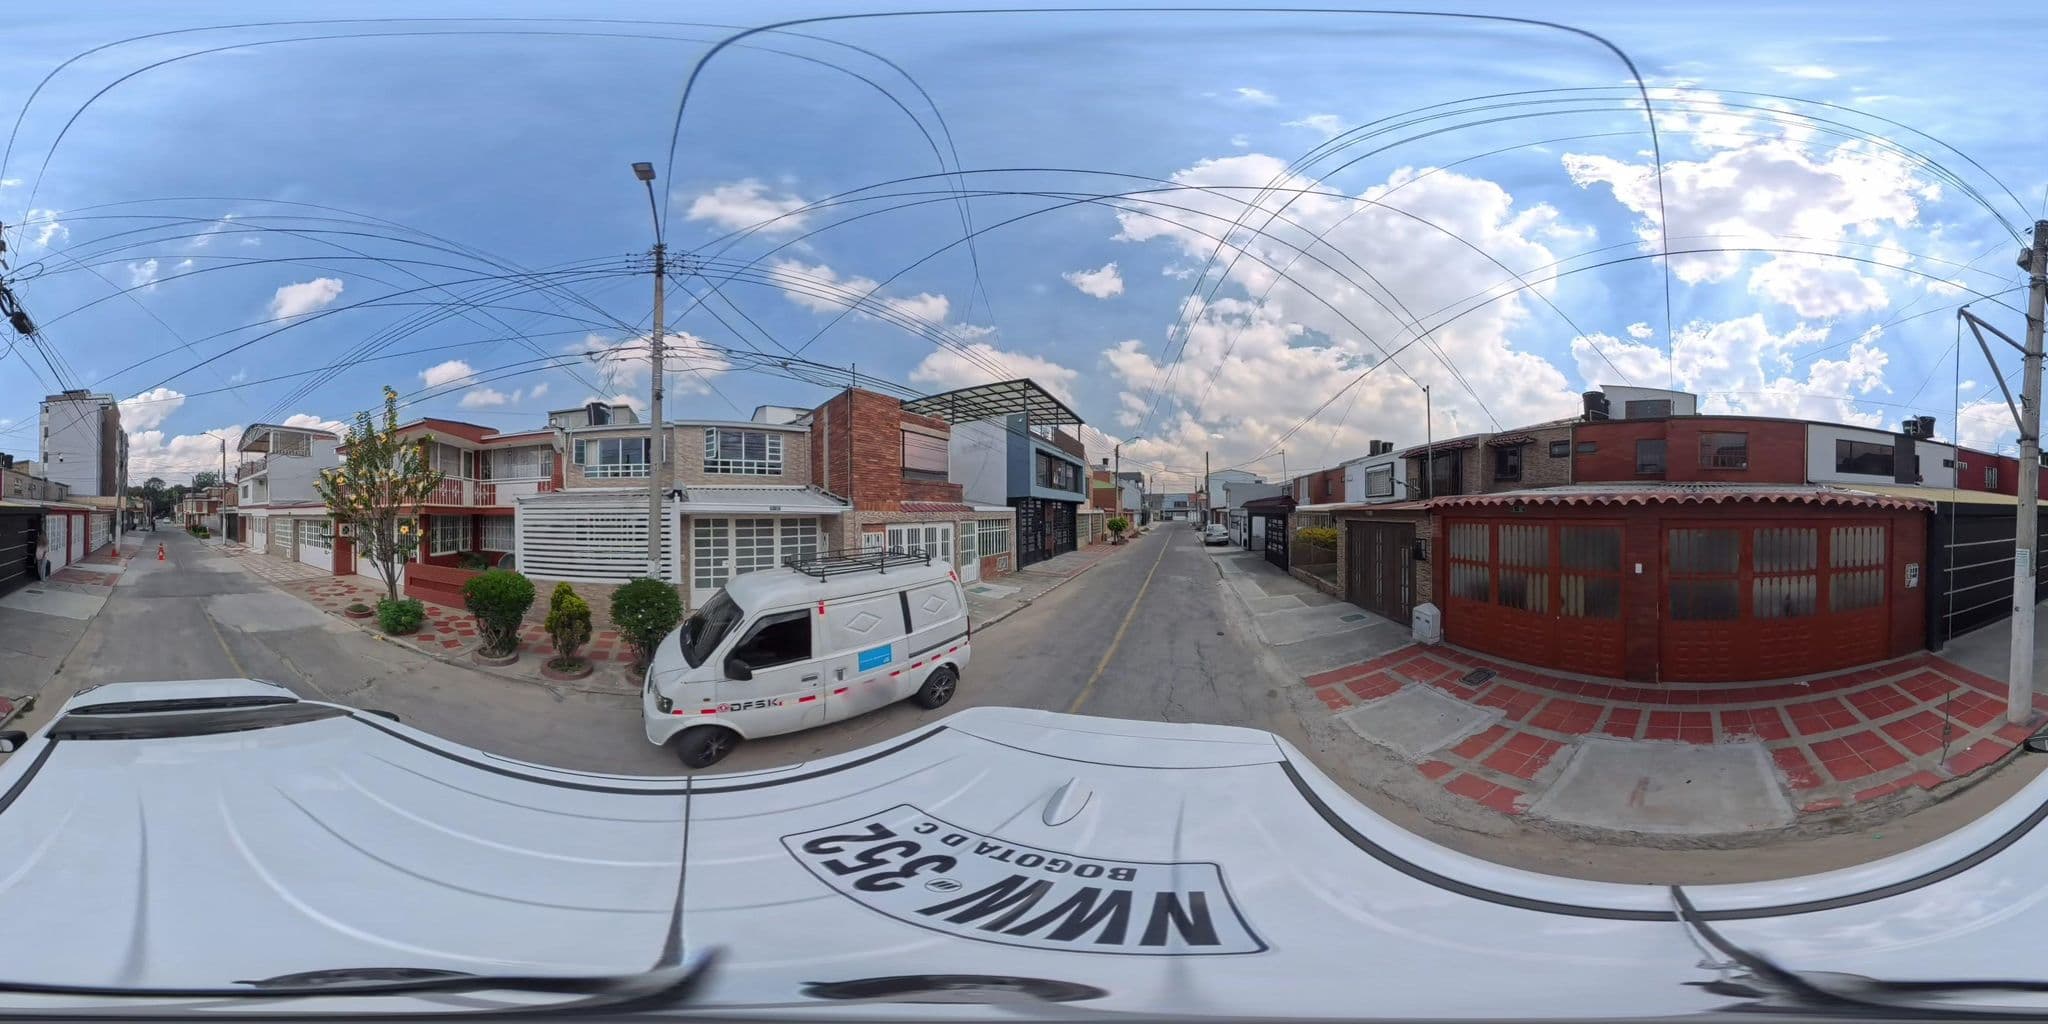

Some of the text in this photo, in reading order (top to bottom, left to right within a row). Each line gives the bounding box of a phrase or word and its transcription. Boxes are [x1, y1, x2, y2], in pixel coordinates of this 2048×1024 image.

[730, 698, 778, 712] DFSK
[973, 841, 1138, 882] BOGOTA
[802, 823, 1222, 946] NWW 352
